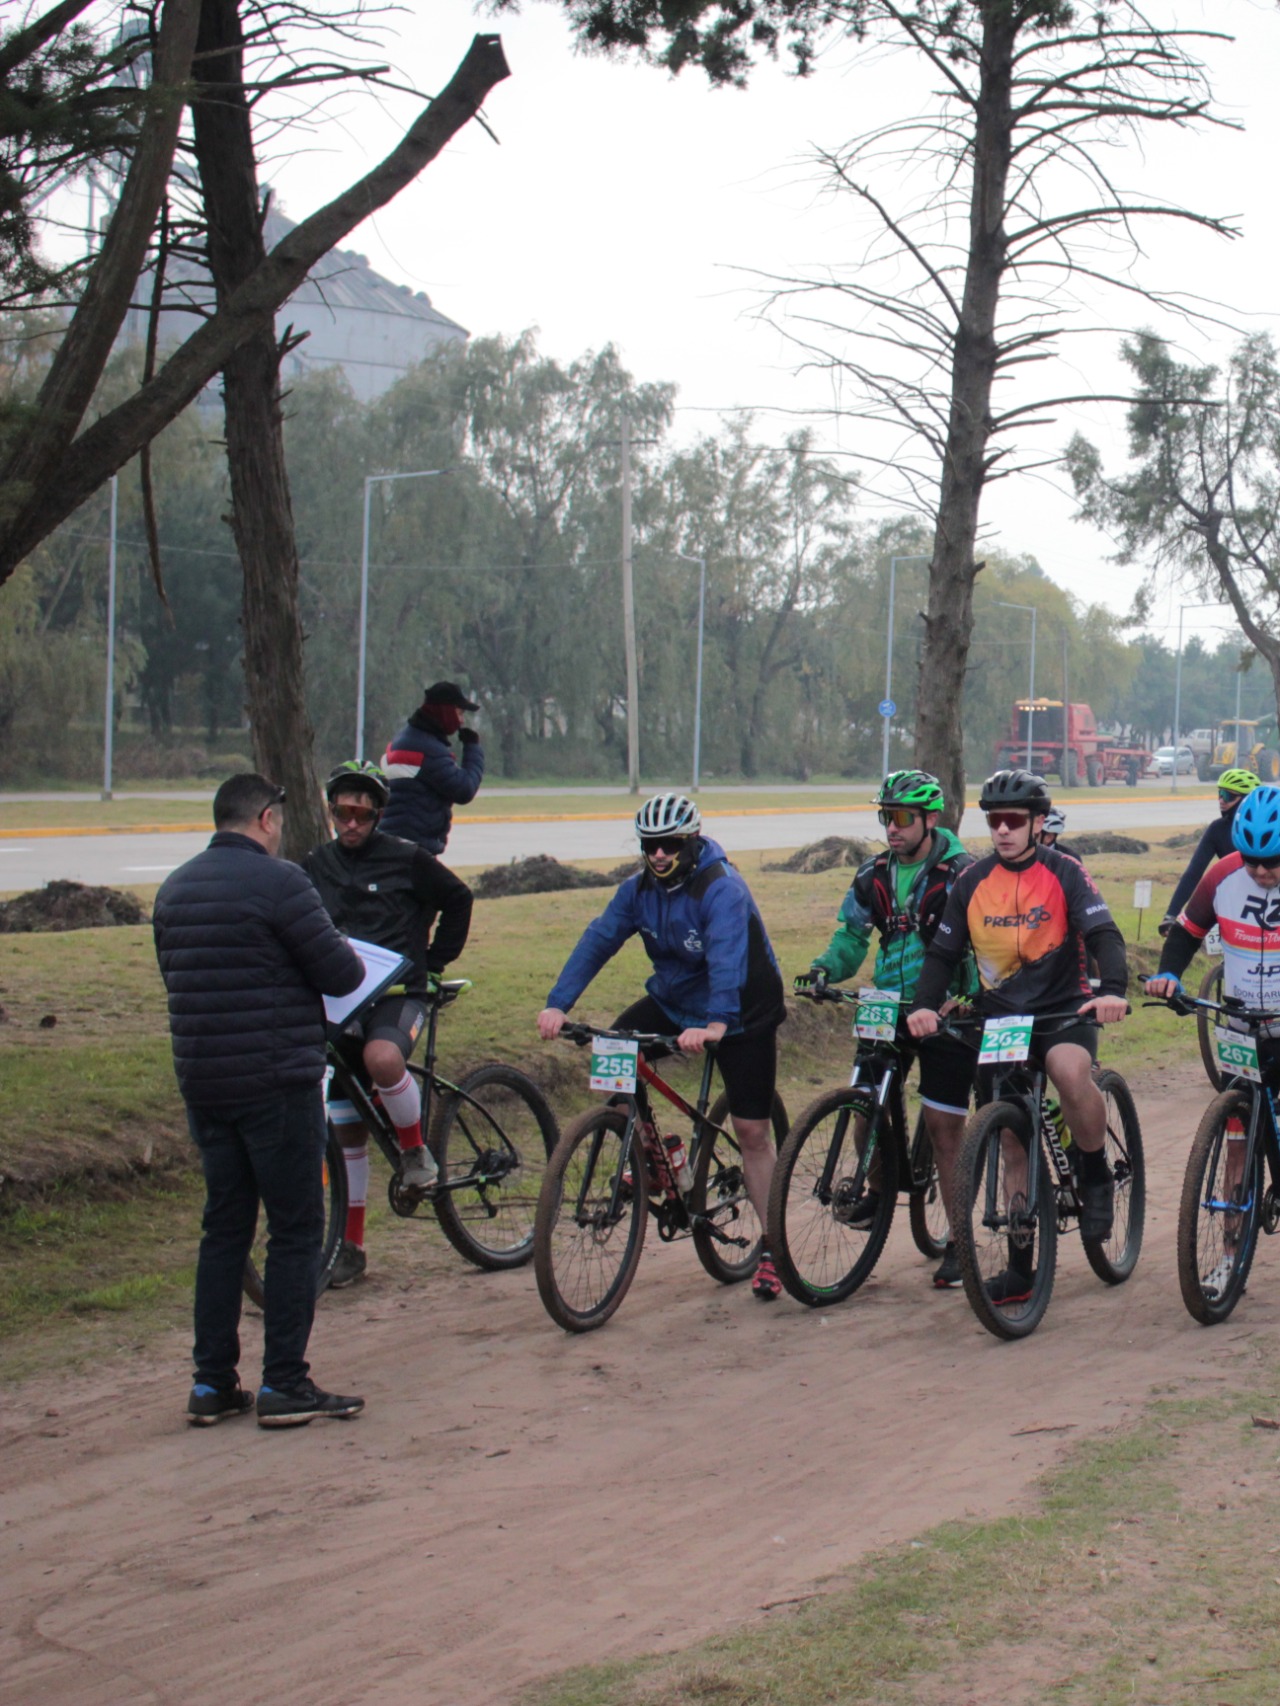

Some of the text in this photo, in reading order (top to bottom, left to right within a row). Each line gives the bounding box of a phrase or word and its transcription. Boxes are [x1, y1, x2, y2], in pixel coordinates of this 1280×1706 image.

[859, 1004, 893, 1023] 263
[985, 1031, 1026, 1048] 262
[1220, 1044, 1253, 1065] 267
[596, 1056, 634, 1076] 255
